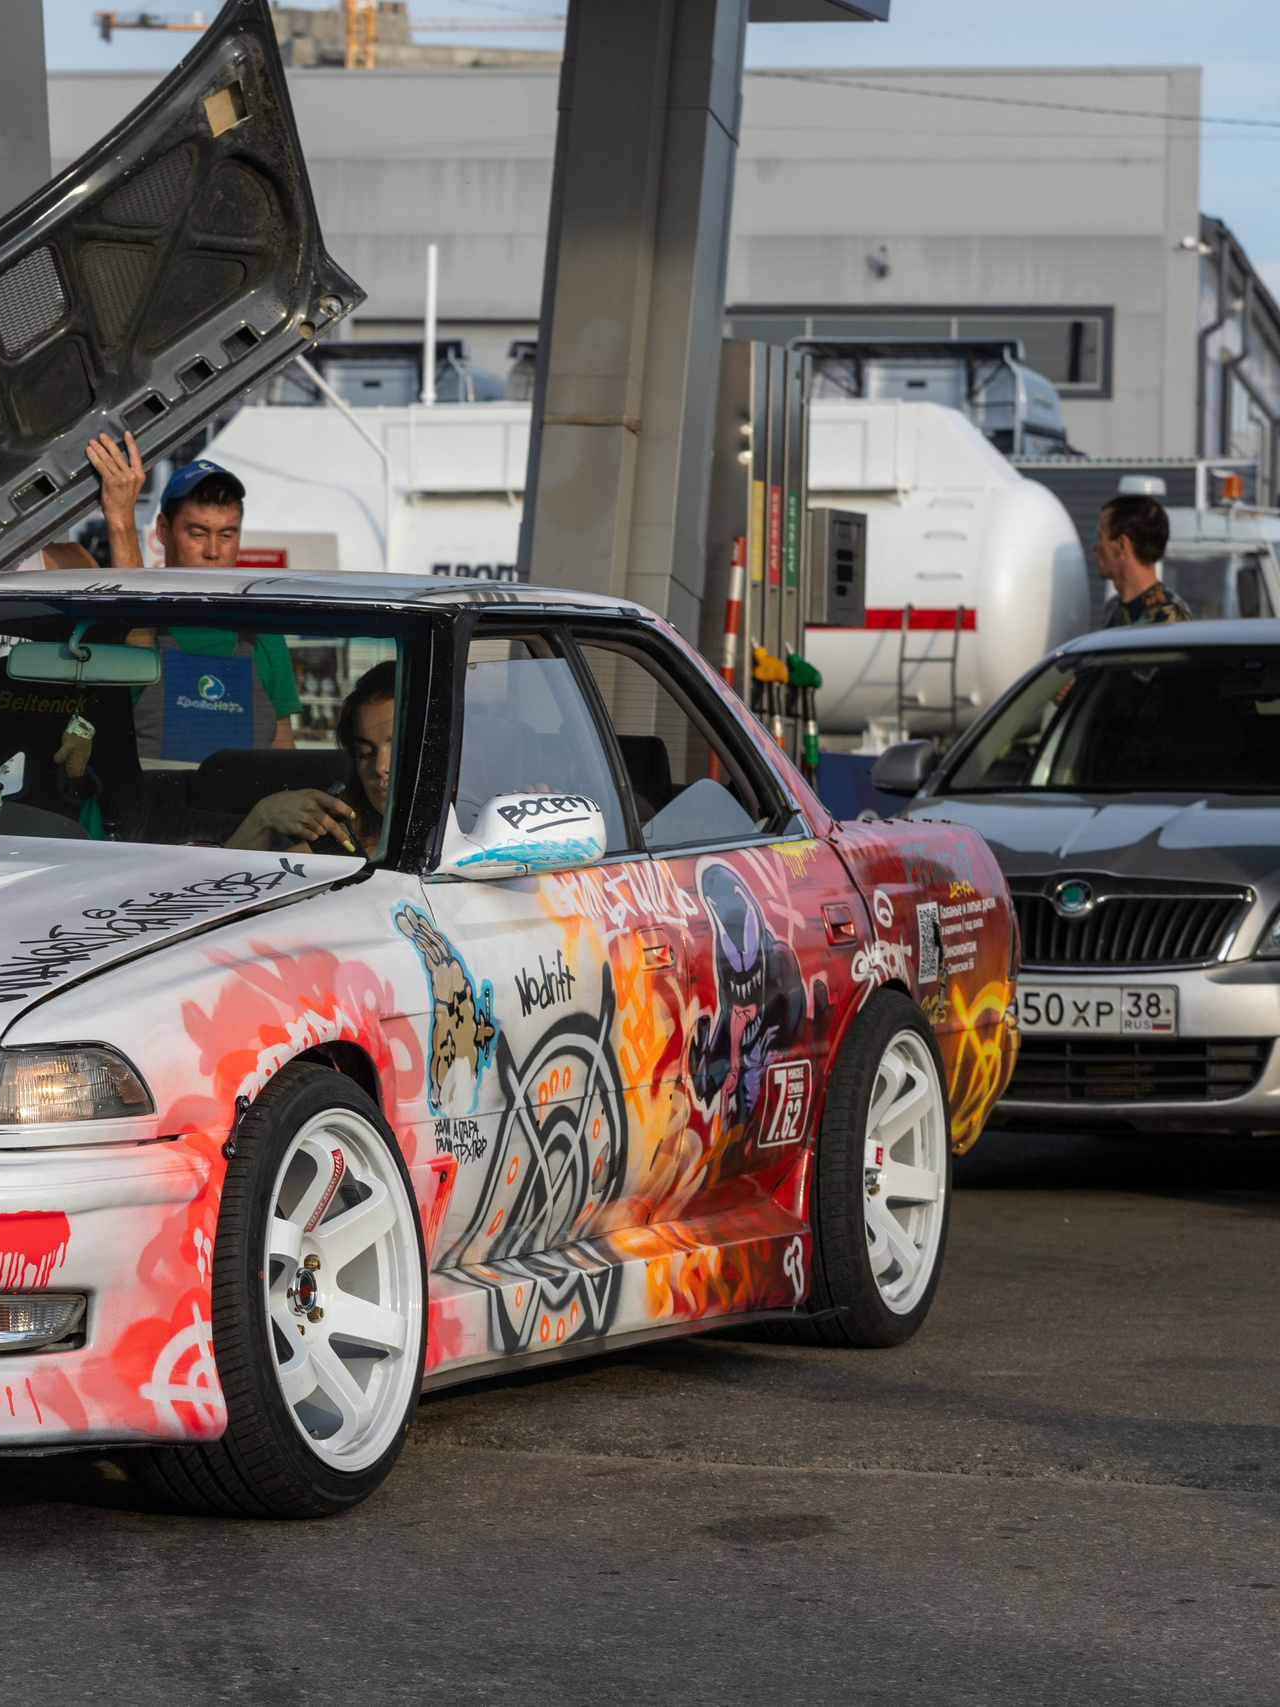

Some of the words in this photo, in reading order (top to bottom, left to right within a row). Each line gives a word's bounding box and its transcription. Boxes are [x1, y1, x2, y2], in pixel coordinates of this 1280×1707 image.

[1014, 992, 1064, 1025] 50
[1072, 1001, 1114, 1027] ХР
[1127, 992, 1161, 1018] 38
[1124, 1020, 1151, 1029] RUS
